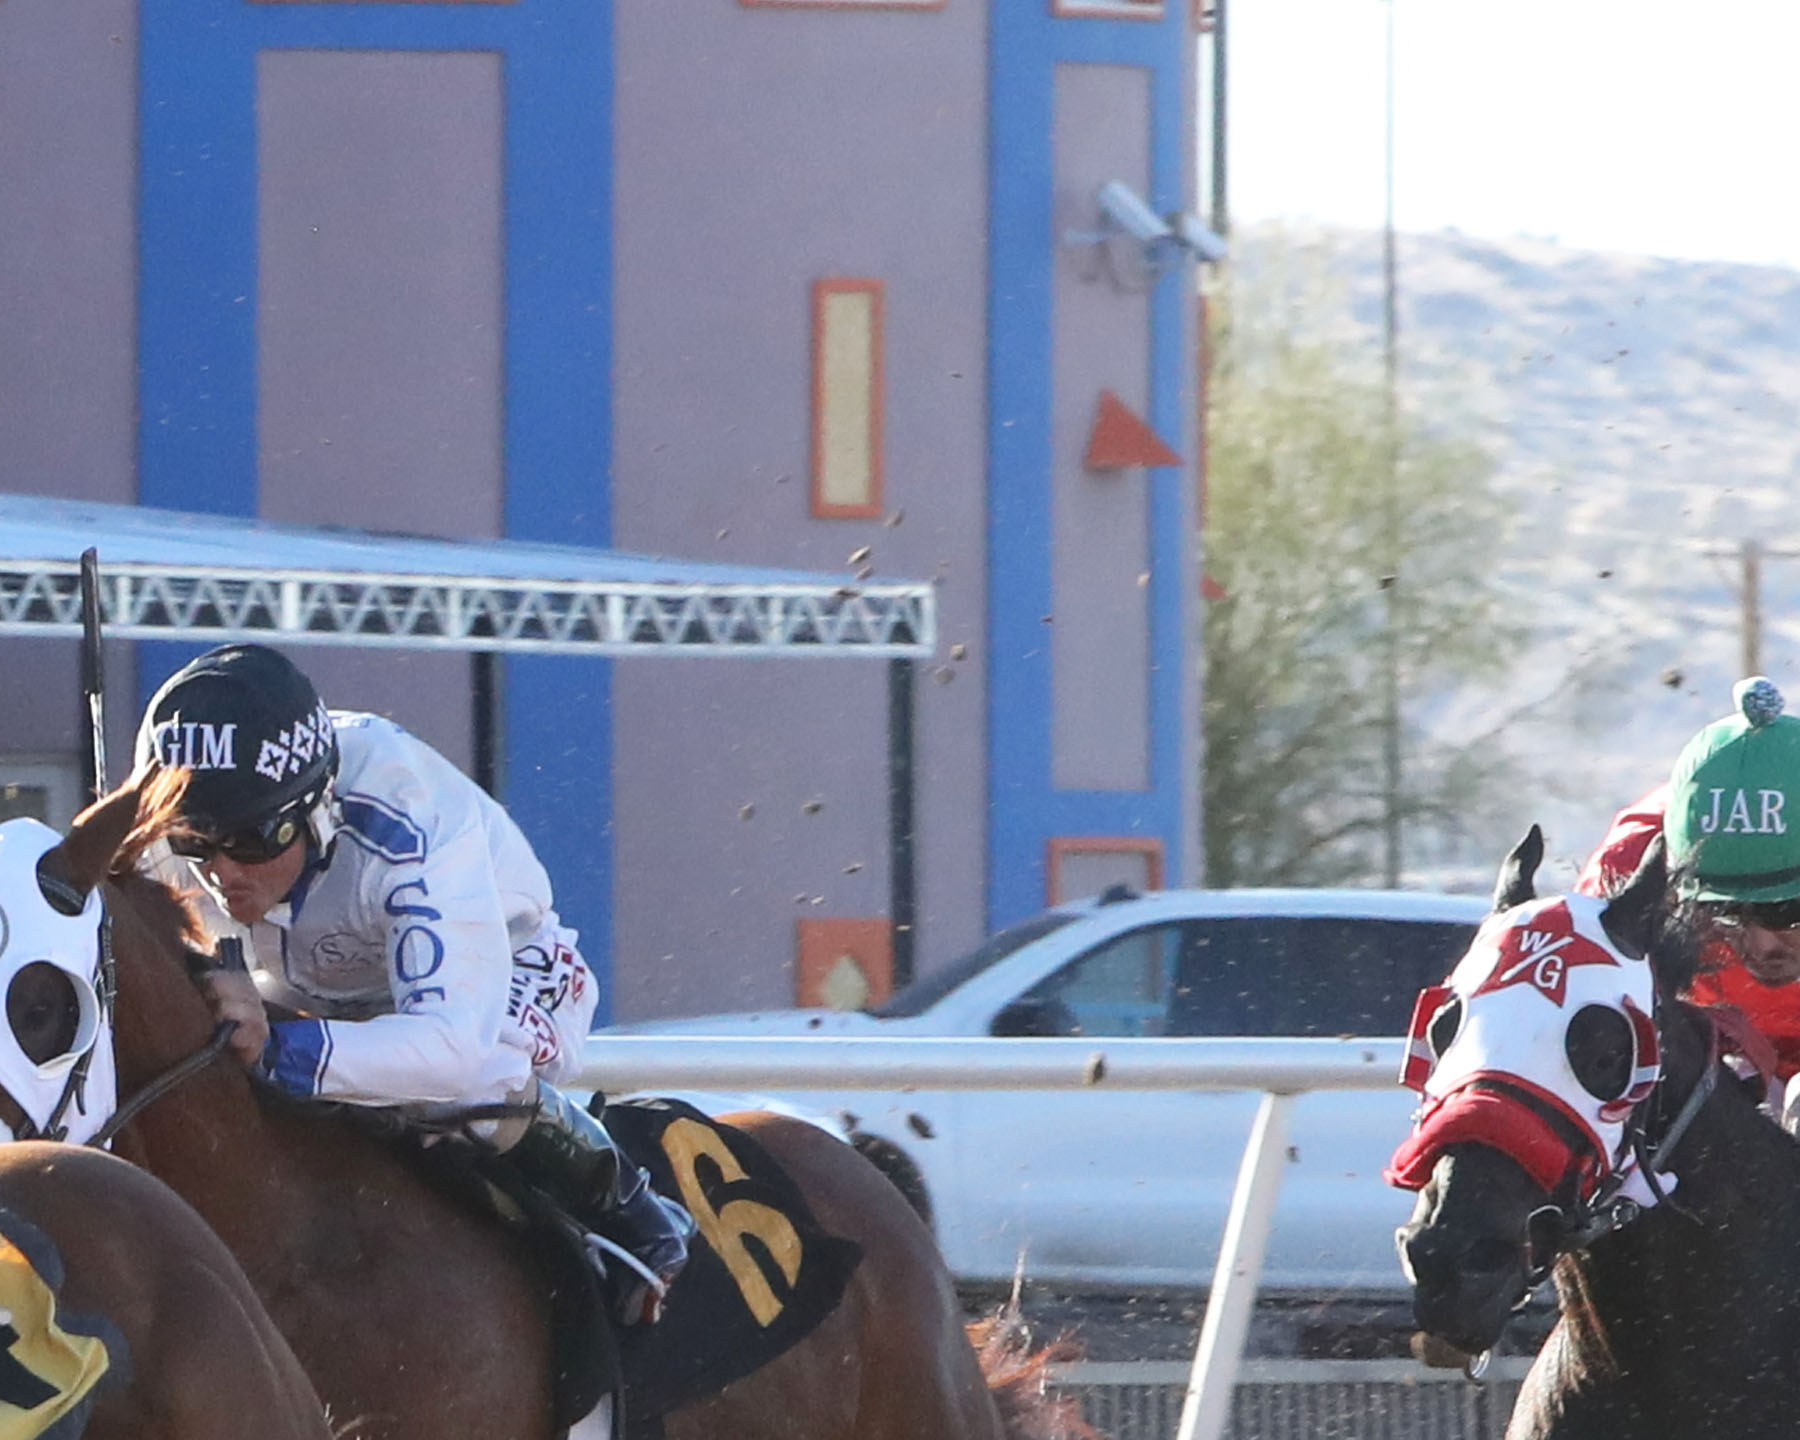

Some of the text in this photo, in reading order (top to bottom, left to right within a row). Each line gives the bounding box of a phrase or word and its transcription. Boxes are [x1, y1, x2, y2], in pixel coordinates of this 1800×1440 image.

[153, 720, 238, 770] GIM
[1701, 788, 1788, 835] JAR
[661, 1117, 803, 1327] 6
